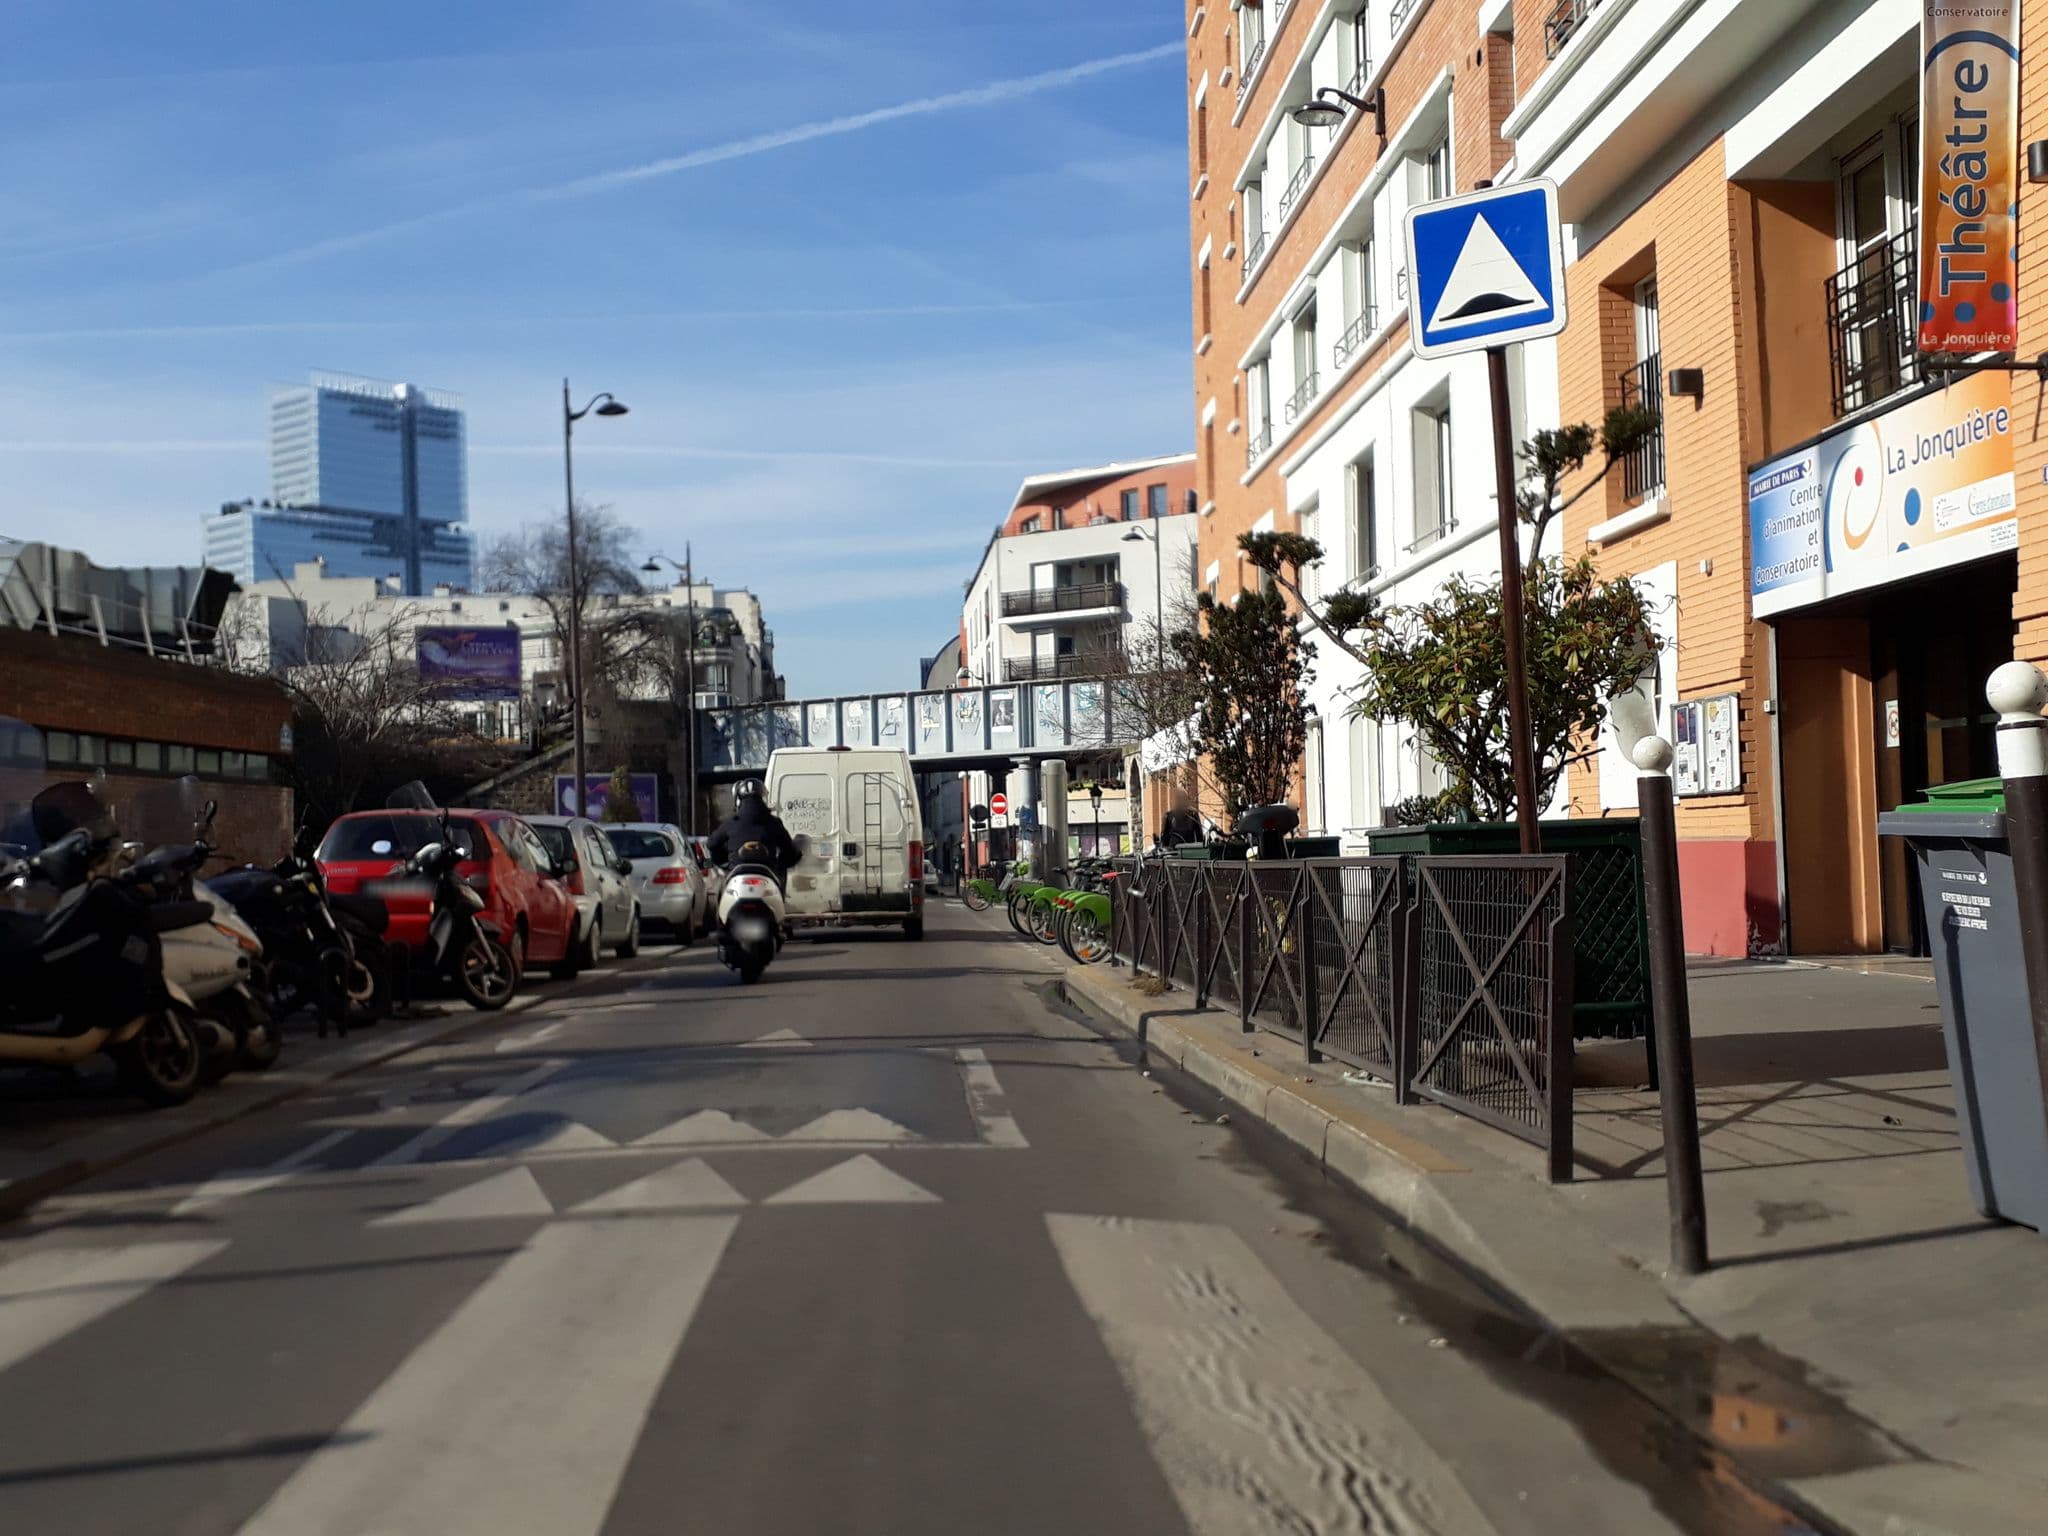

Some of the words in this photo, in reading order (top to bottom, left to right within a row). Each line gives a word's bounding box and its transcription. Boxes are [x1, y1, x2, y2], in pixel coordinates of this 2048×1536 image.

[1927, 6, 2009, 17] Conservatoire
[1938, 59, 1989, 297] Théâtre
[1921, 331, 1938, 345] La
[1942, 331, 2011, 347] Jonquière
[1886, 445, 1906, 475] La
[1912, 408, 2008, 466] Jonquière
[1781, 467, 1800, 484] PARIS
[1789, 483, 1823, 507] Centre
[1764, 506, 1821, 539] d'animation
[1808, 528, 1819, 546] et
[1756, 552, 1819, 585] Conservatoire
